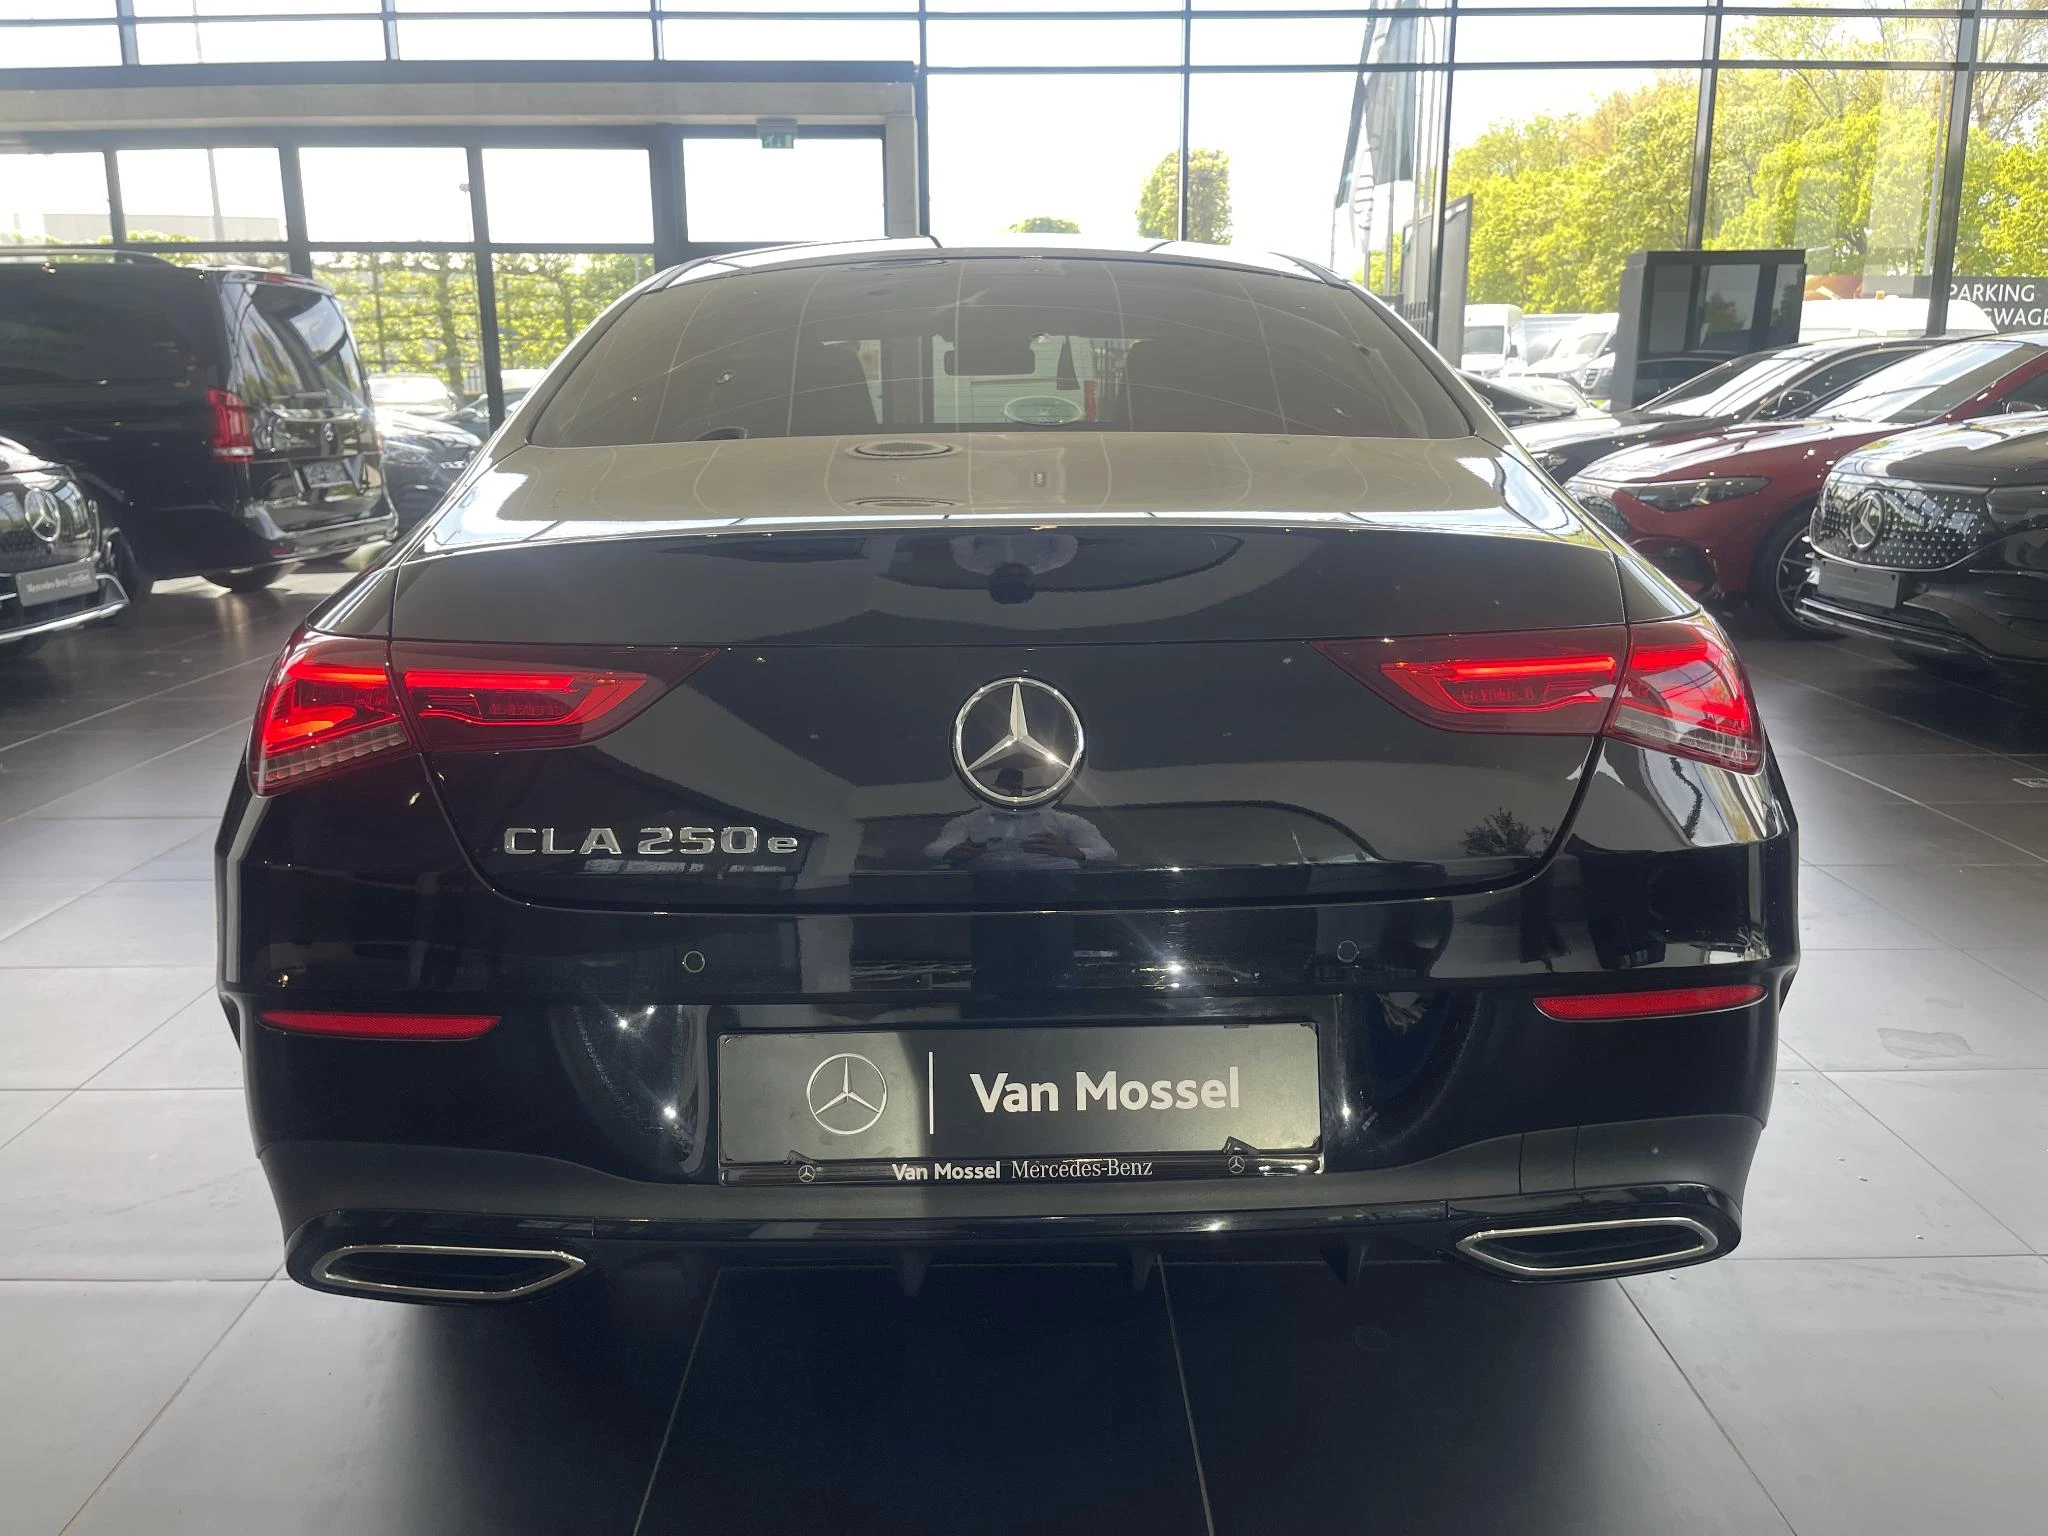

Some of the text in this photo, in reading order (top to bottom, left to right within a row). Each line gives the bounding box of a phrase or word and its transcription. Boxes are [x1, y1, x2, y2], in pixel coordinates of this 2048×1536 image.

[1949, 283, 2035, 302] PARKING
[504, 827, 622, 855] CLA
[969, 1066, 1240, 1113] Van Mossel
[891, 1158, 1153, 1181] Van Mossel Mercedes-Benz
